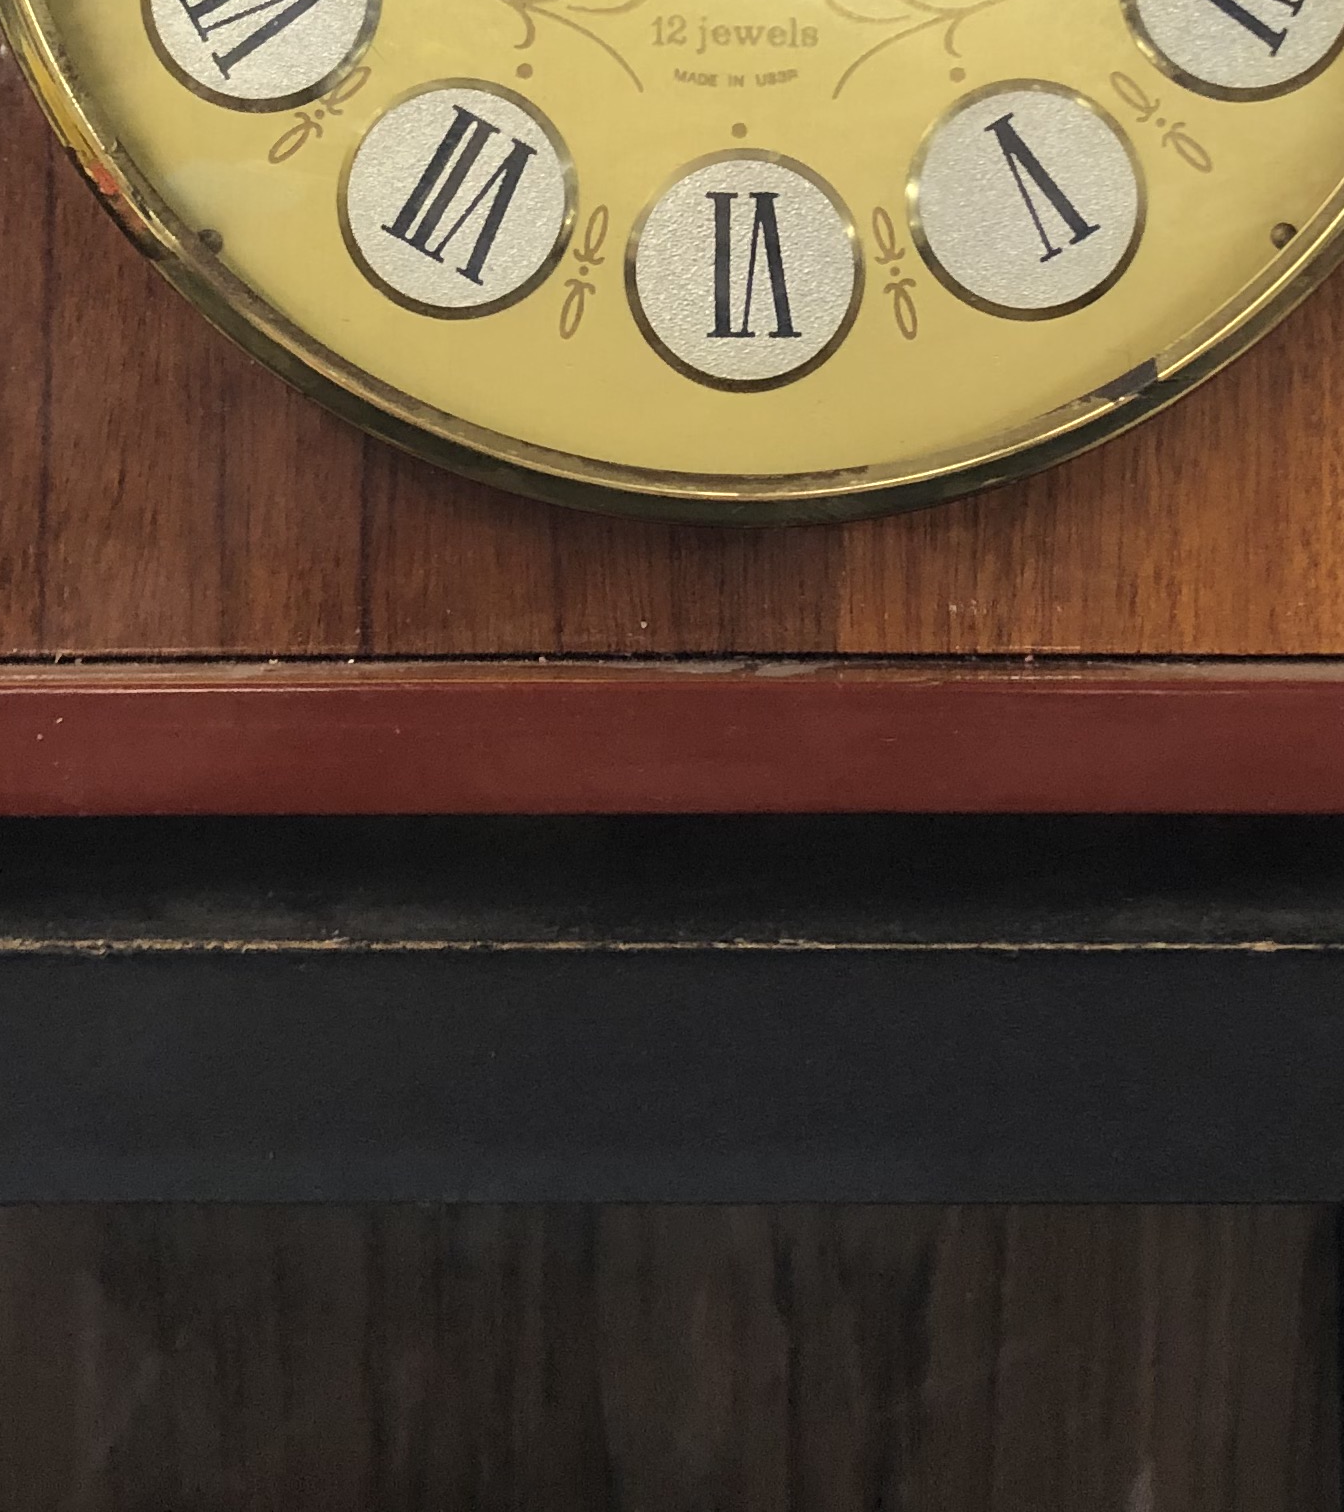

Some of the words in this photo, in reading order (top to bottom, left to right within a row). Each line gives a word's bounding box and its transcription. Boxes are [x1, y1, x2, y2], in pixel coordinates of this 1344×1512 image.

[651, 14, 687, 46] 12
[696, 16, 819, 55] jewels
[674, 68, 718, 87] MADE
[728, 74, 745, 88] IN
[381, 104, 538, 286] VII
[984, 112, 1101, 263] V
[706, 191, 802, 338] VI
